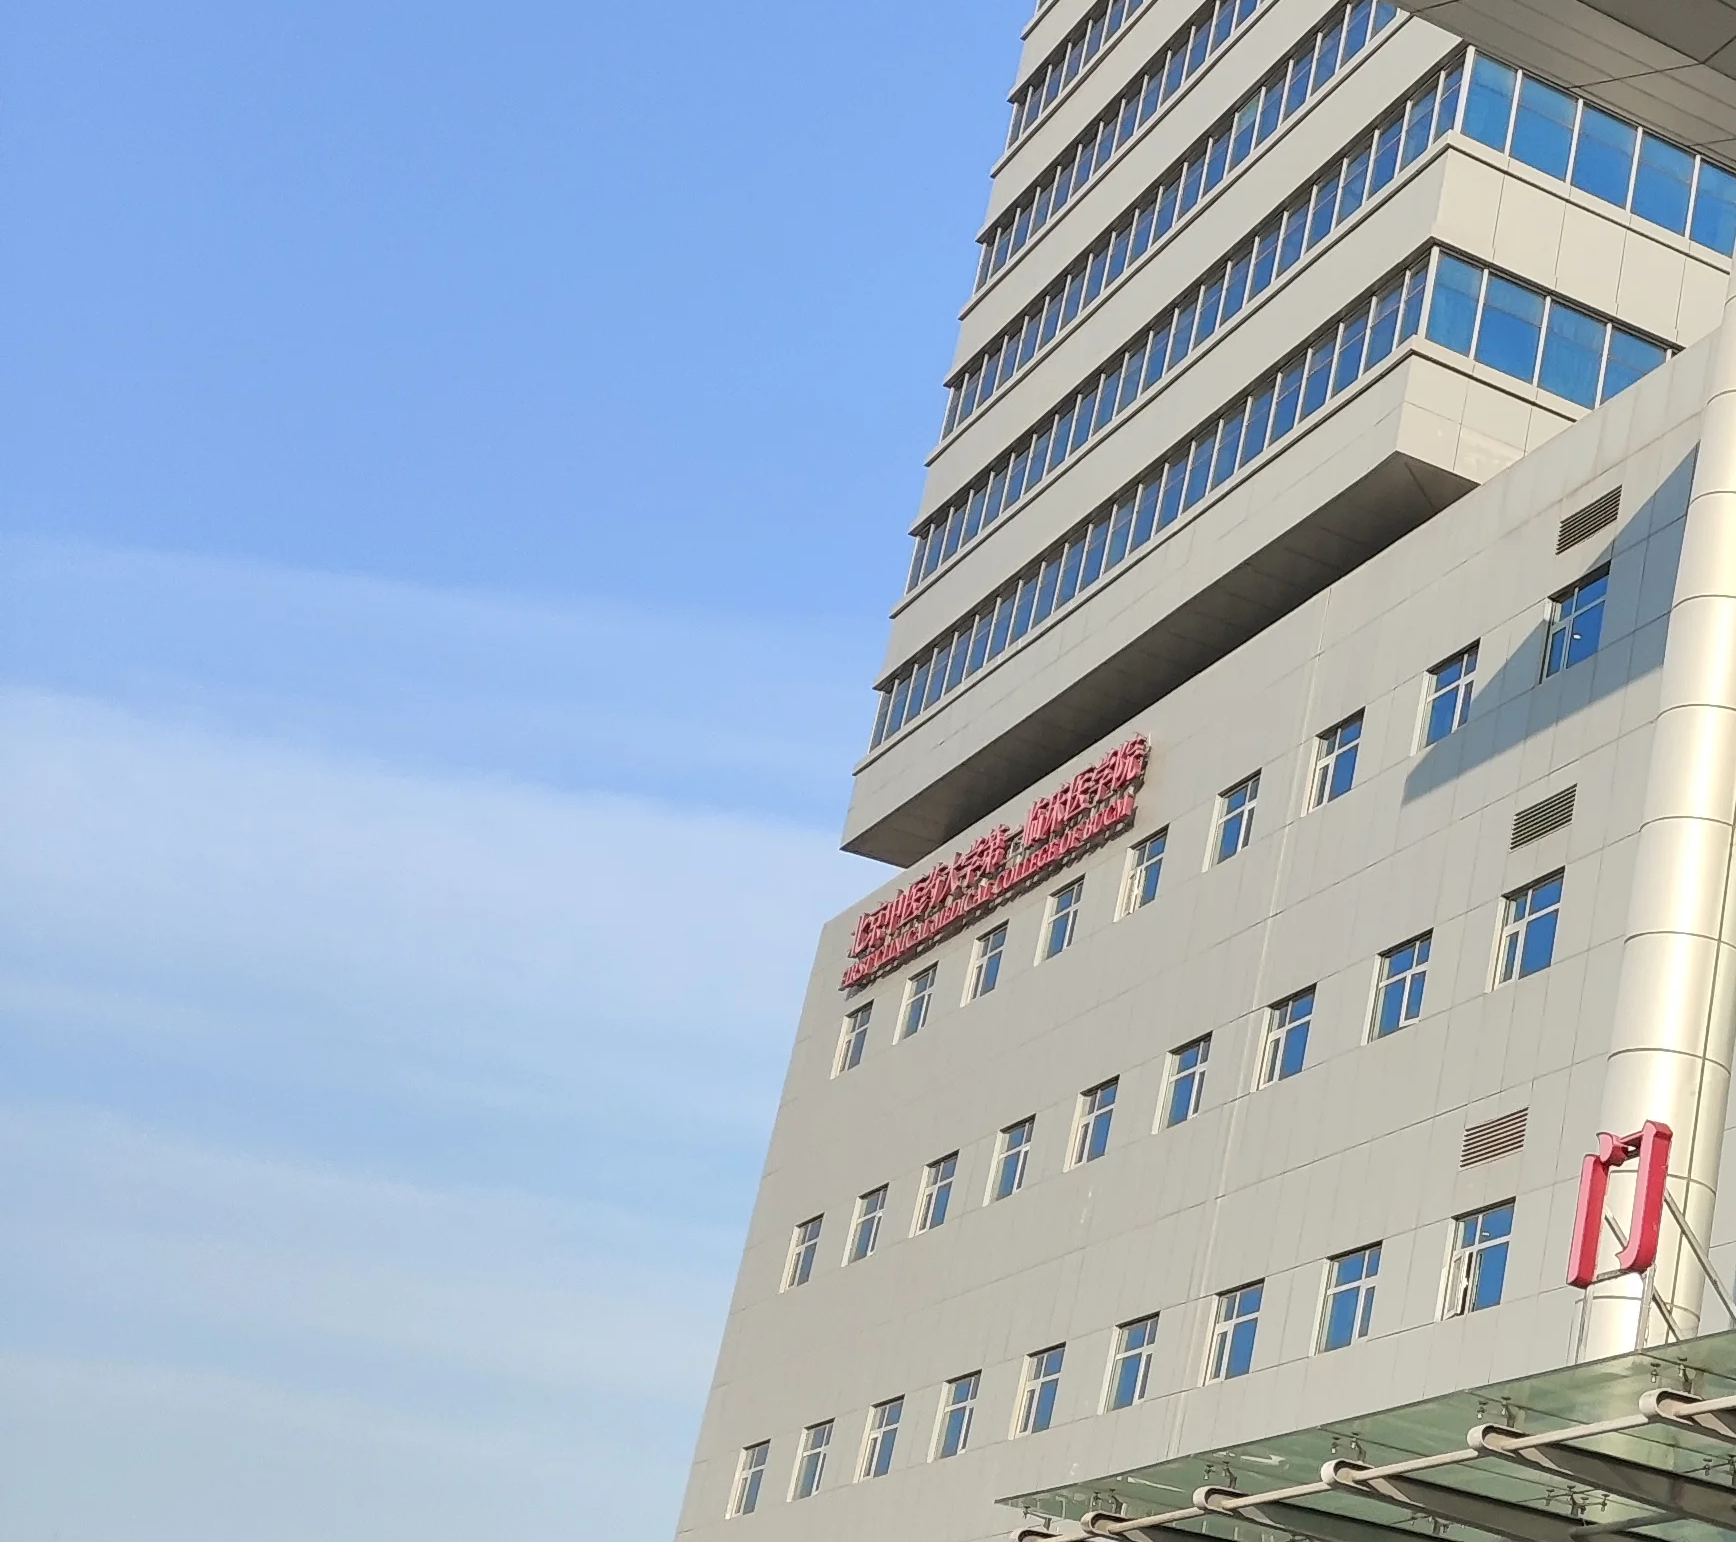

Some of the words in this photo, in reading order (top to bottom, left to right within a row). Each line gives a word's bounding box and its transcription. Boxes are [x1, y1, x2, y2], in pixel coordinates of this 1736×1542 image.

[842, 951, 876, 988] FIRST
[874, 921, 933, 970] CLINICAL
[931, 883, 996, 937] MEDICAL
[994, 841, 1060, 893] COLLEGE
[1059, 827, 1085, 854] OF
[1083, 794, 1136, 841] BUCM
